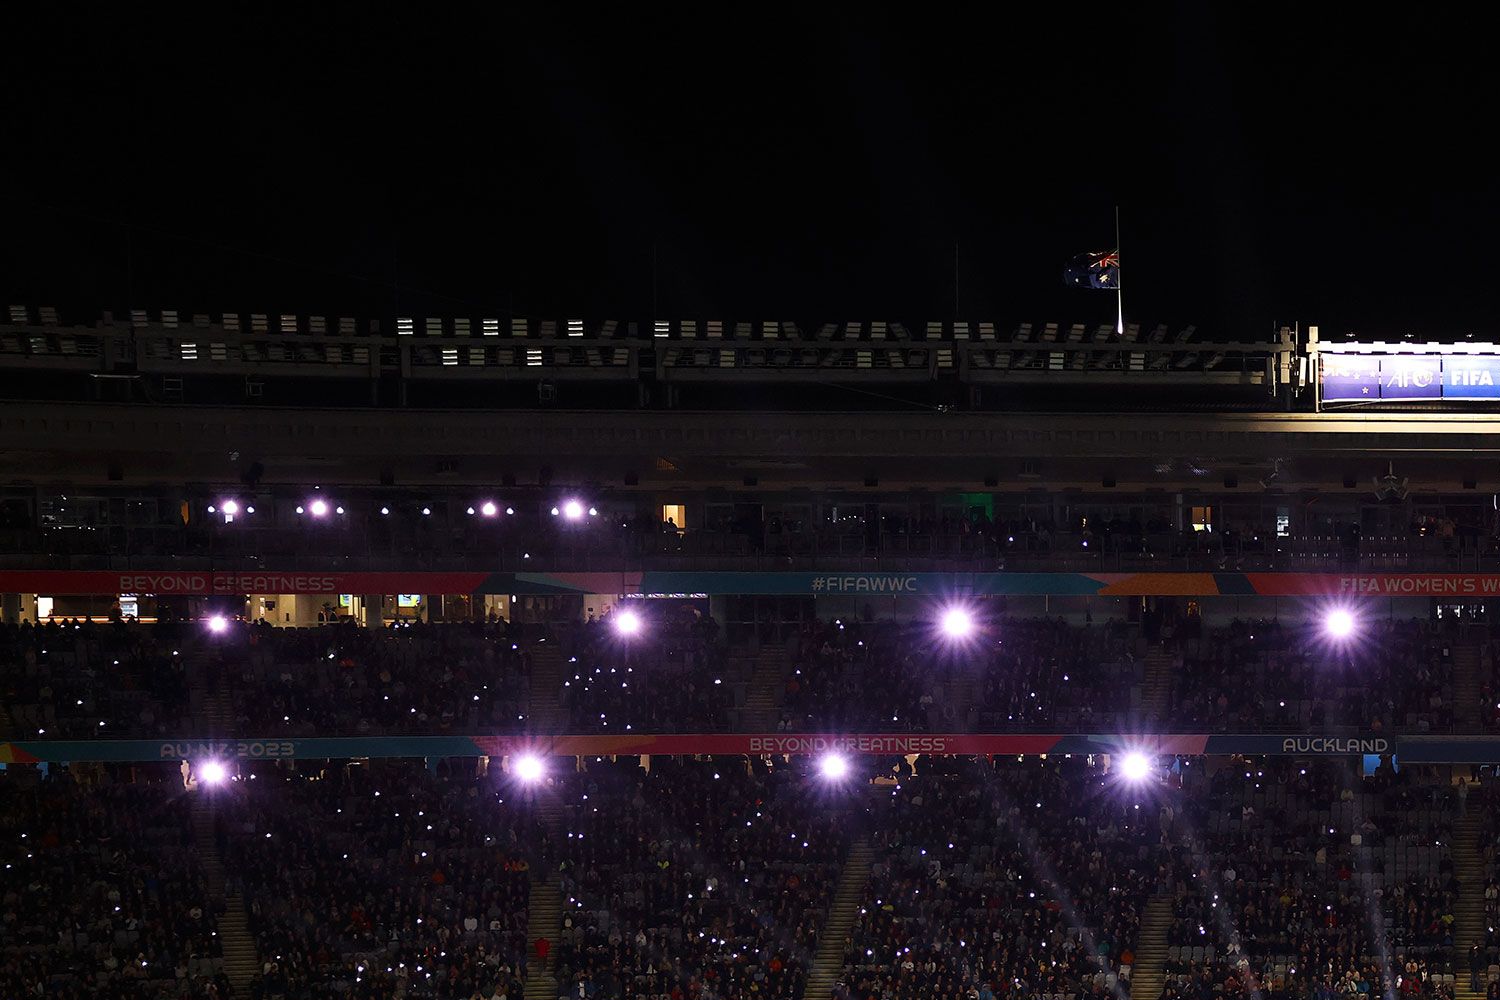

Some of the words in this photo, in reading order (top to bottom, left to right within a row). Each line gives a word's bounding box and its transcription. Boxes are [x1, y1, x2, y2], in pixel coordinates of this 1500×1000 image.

[1451, 370, 1494, 386] FIFA
[119, 576, 206, 591] BEYOND
[811, 577, 917, 592] #FIFAWWC
[1340, 578, 1379, 593] FIFA
[1384, 578, 1475, 593] WOMEN'S
[749, 737, 826, 752] BEYOND
[1282, 738, 1388, 752] AUCKLAND
